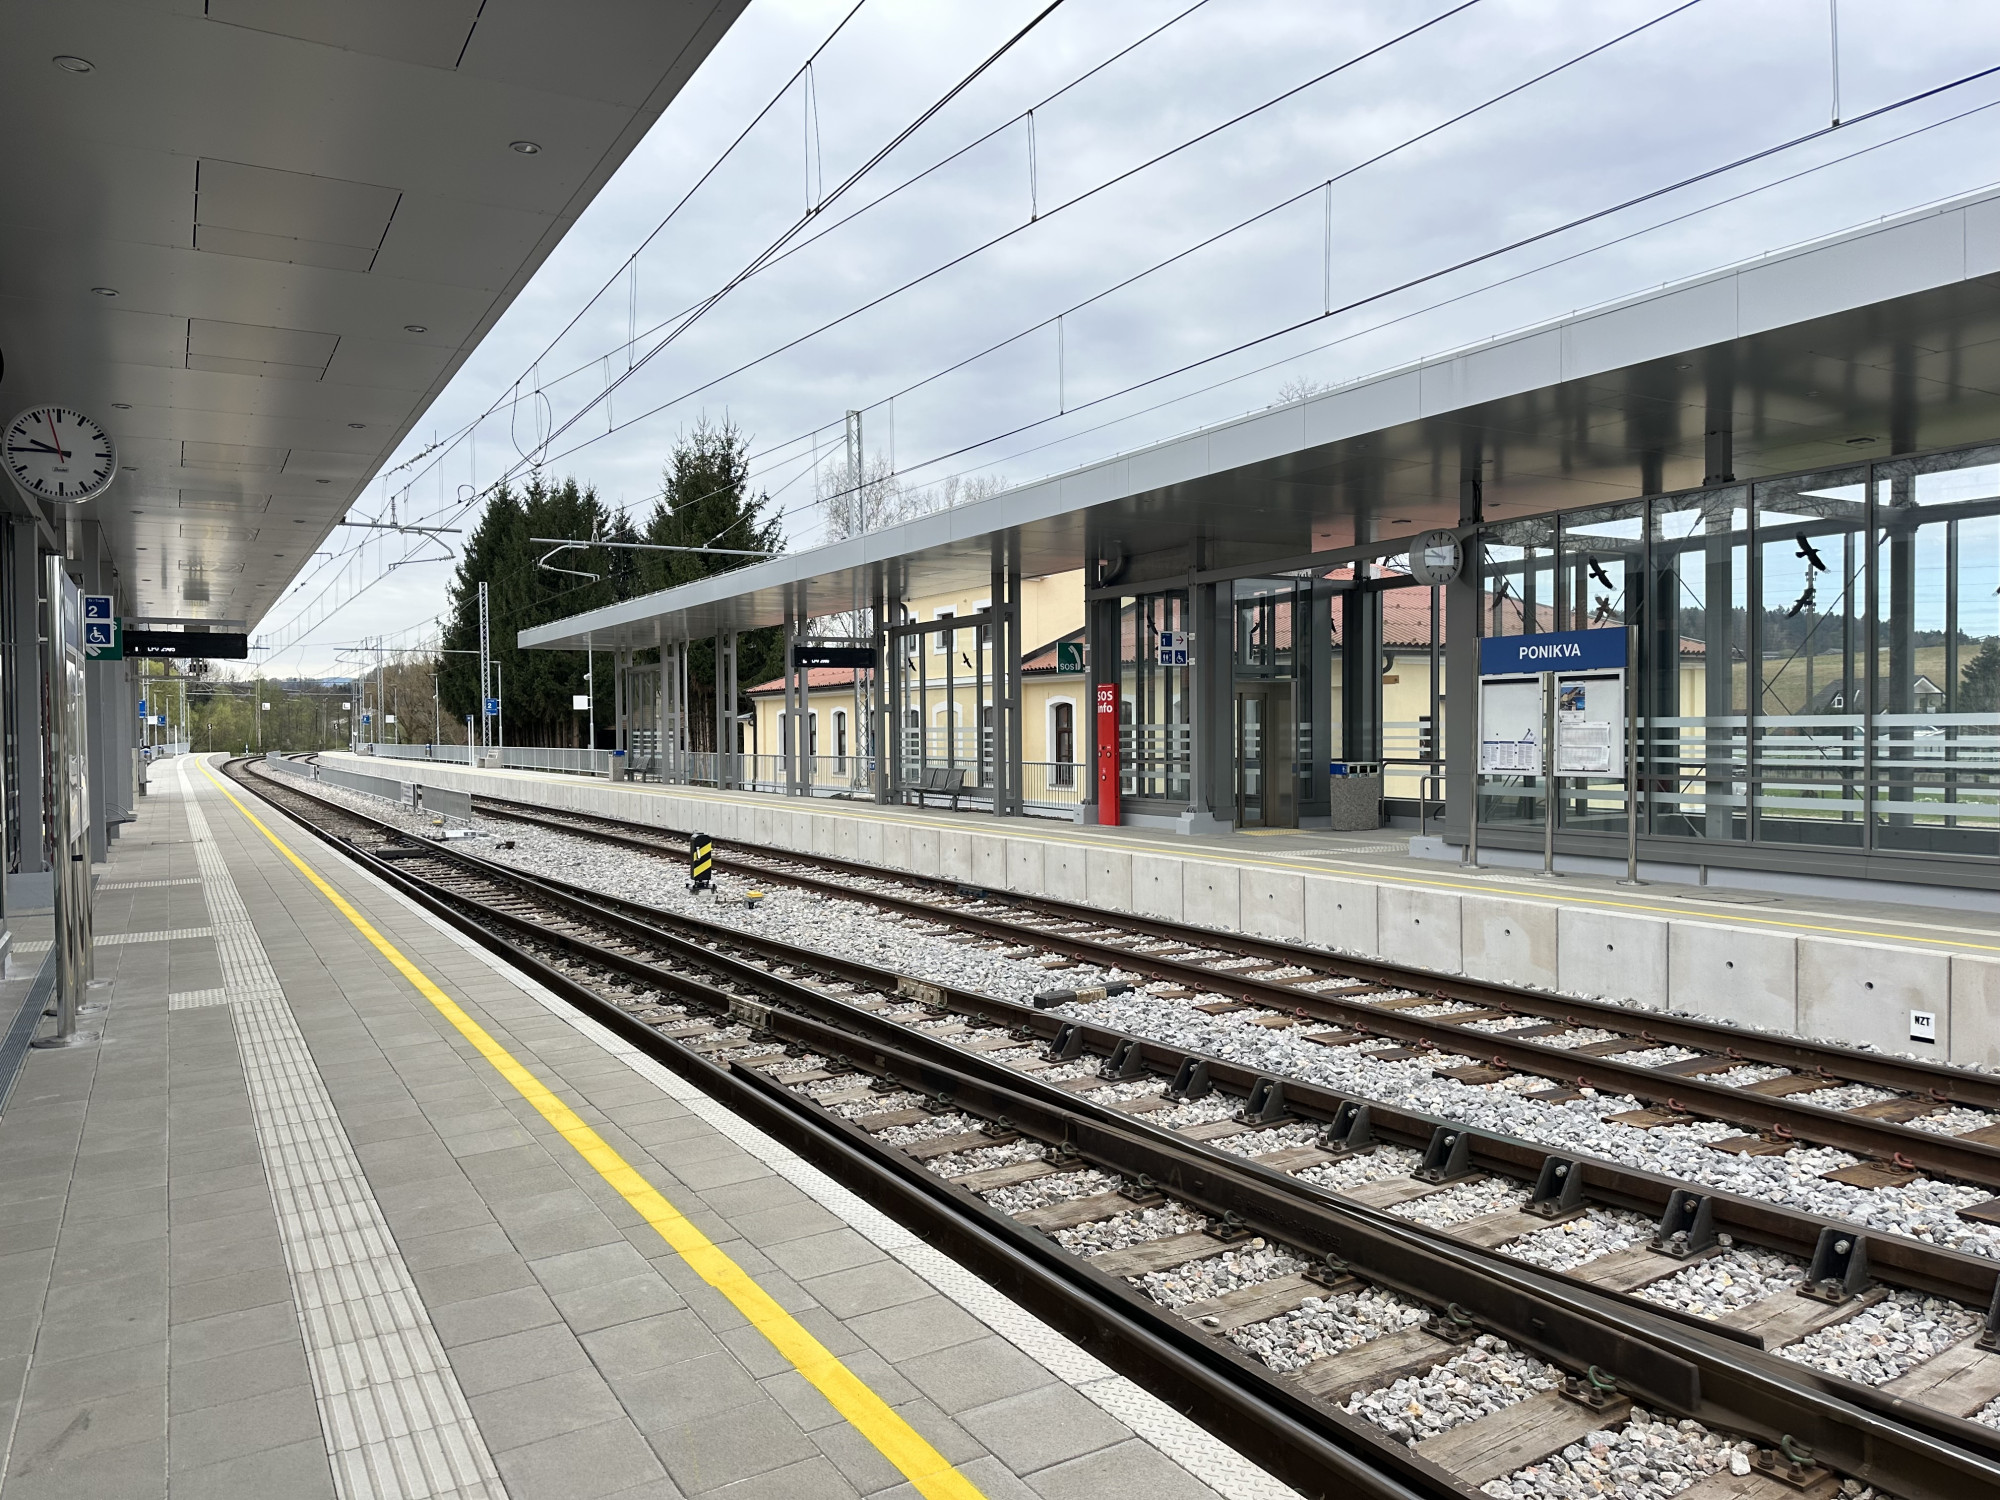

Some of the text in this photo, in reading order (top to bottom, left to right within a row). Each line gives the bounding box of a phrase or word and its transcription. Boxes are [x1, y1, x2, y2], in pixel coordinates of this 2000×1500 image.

[88, 605, 98, 617] 2
[1519, 643, 1582, 660] PONIKVA
[1060, 662, 1075, 671] SOS
[1097, 702, 1113, 713] info
[1914, 1015, 1931, 1027] NZT
